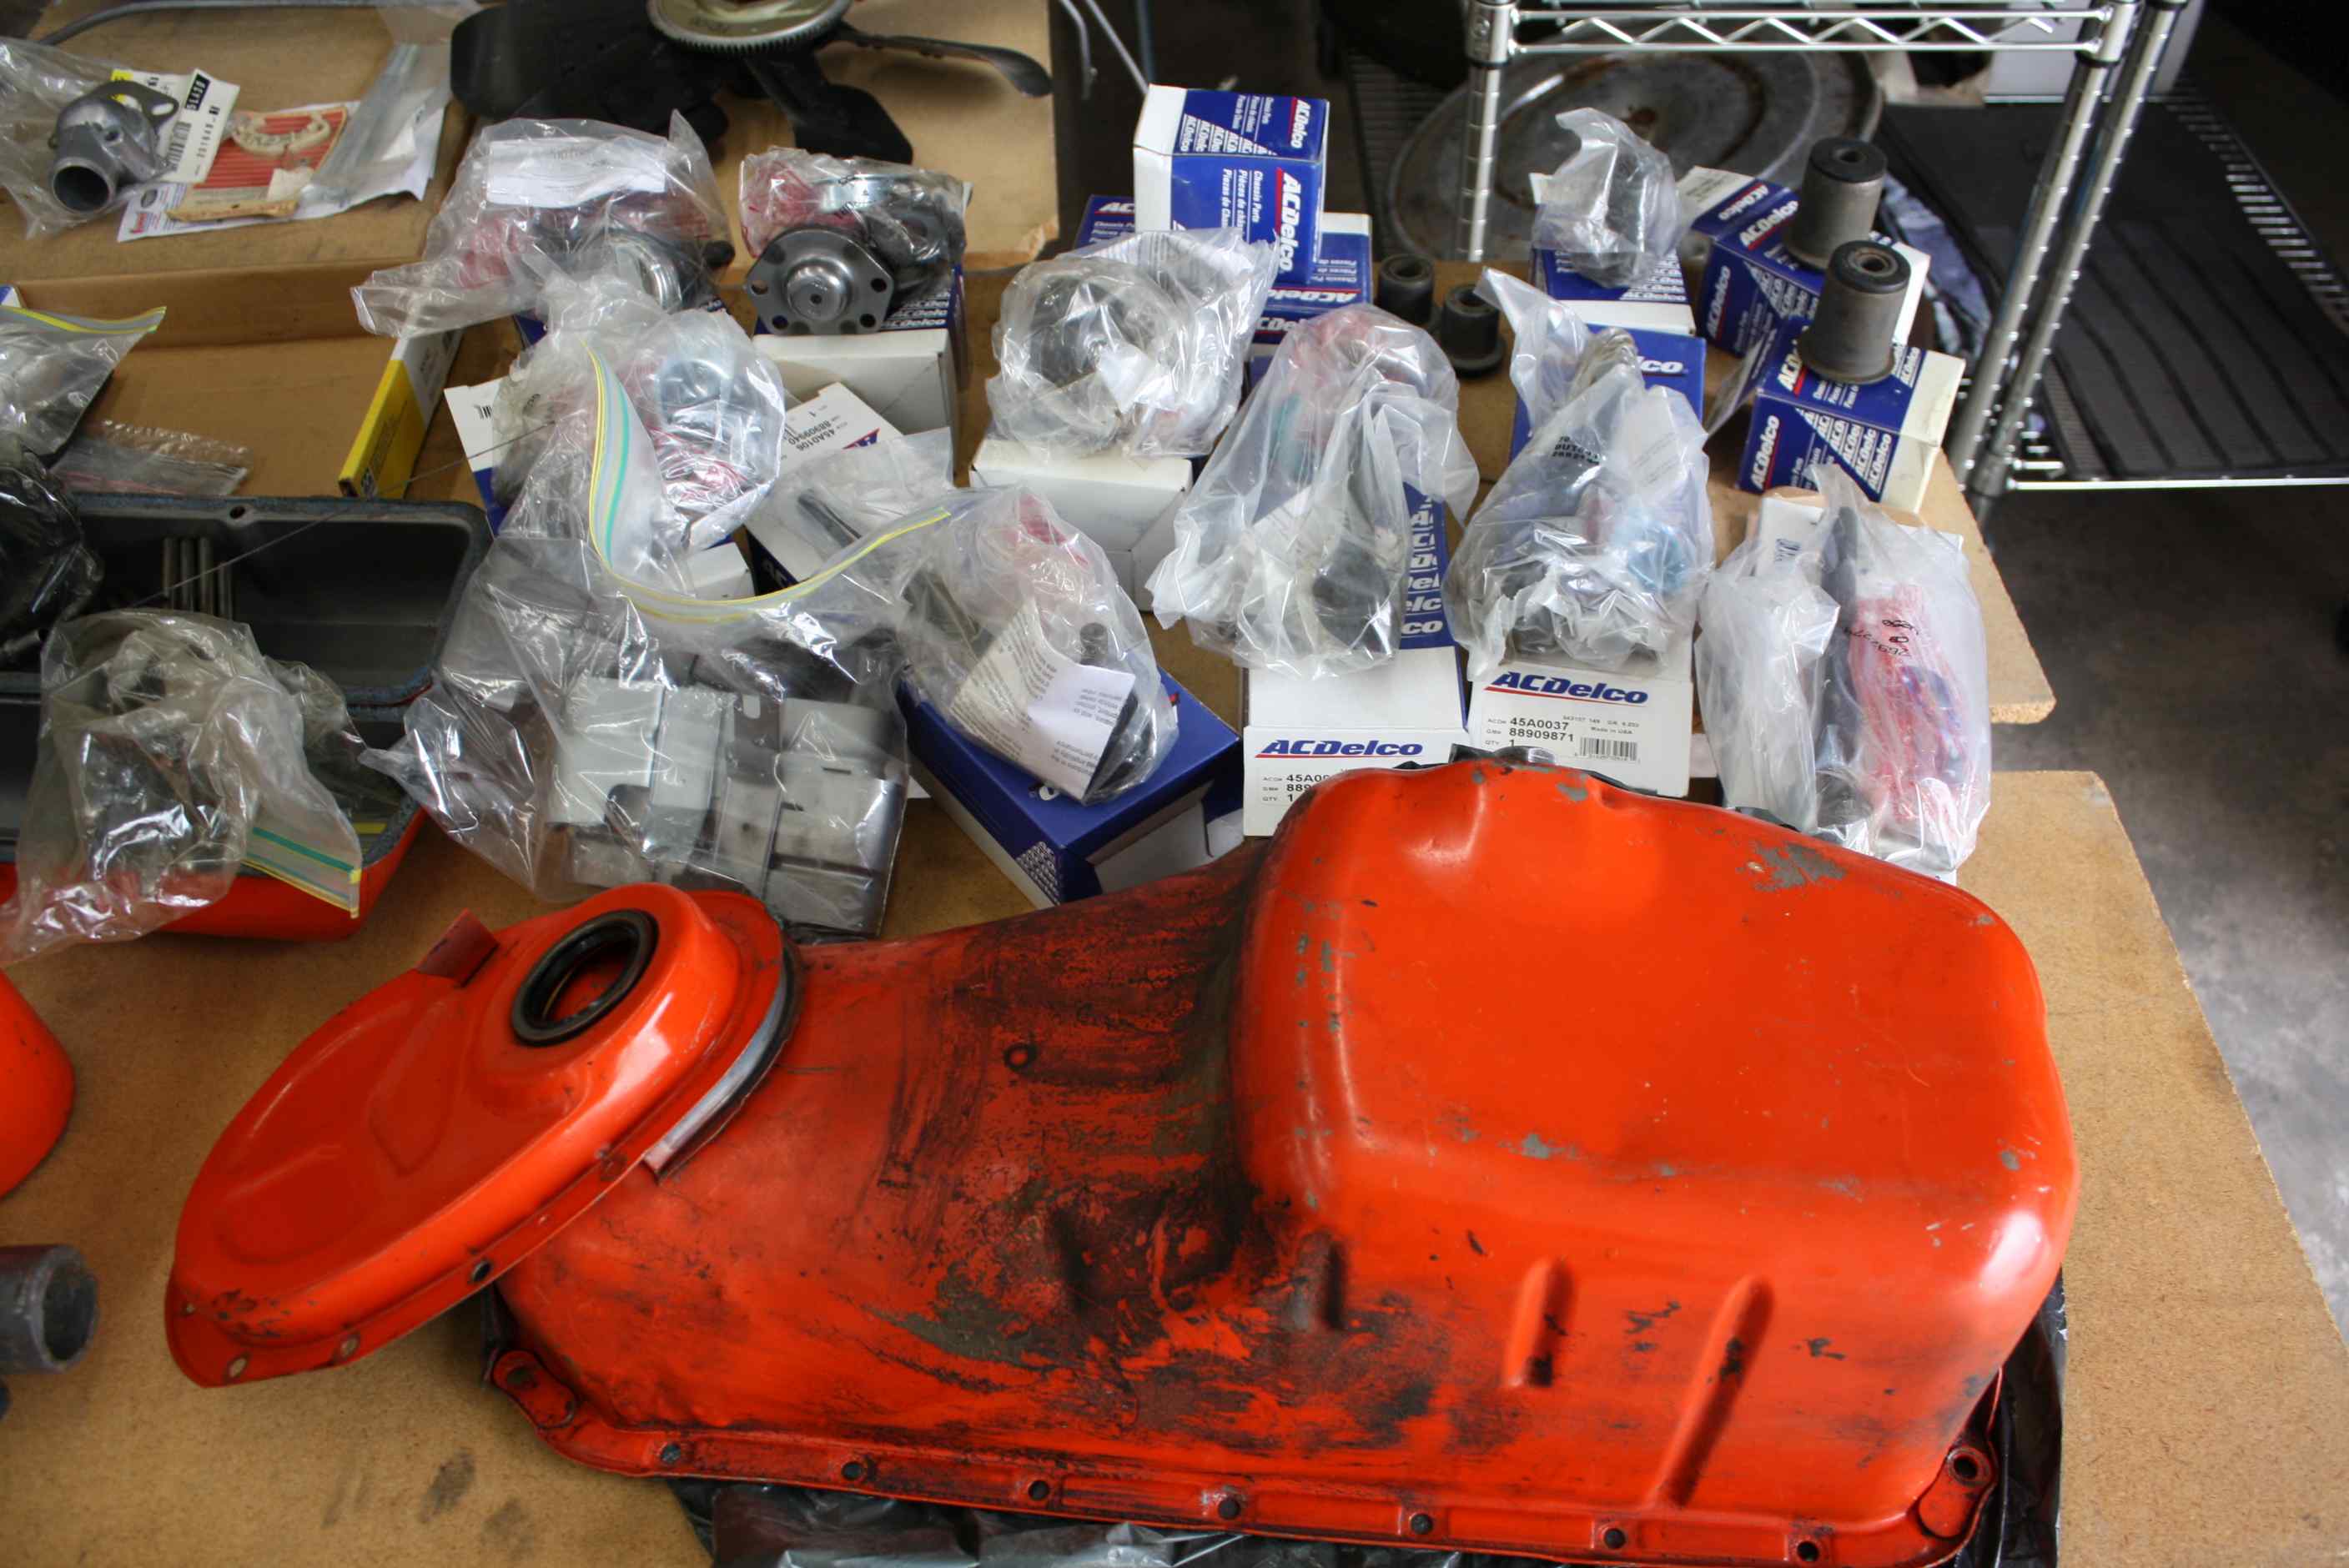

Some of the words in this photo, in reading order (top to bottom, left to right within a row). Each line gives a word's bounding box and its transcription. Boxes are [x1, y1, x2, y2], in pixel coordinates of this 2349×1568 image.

[1290, 99, 1311, 149] ACDelco
[1222, 197, 1232, 207] de
[1253, 170, 1264, 202] Chassis
[1238, 199, 1246, 209] de
[1252, 203, 1262, 224] Parts
[1279, 172, 1302, 272] ACDelco
[1739, 200, 1799, 247] ACDelco
[1707, 265, 1732, 340] ACDelco
[1751, 415, 1780, 490] ACDelco
[1868, 433, 1893, 490] ACDelco
[1491, 671, 1649, 705] ACDelco
[1509, 727, 1575, 743] 88909871
[1510, 716, 1569, 731] 45A0037
[1261, 740, 1424, 756] ACDelco
